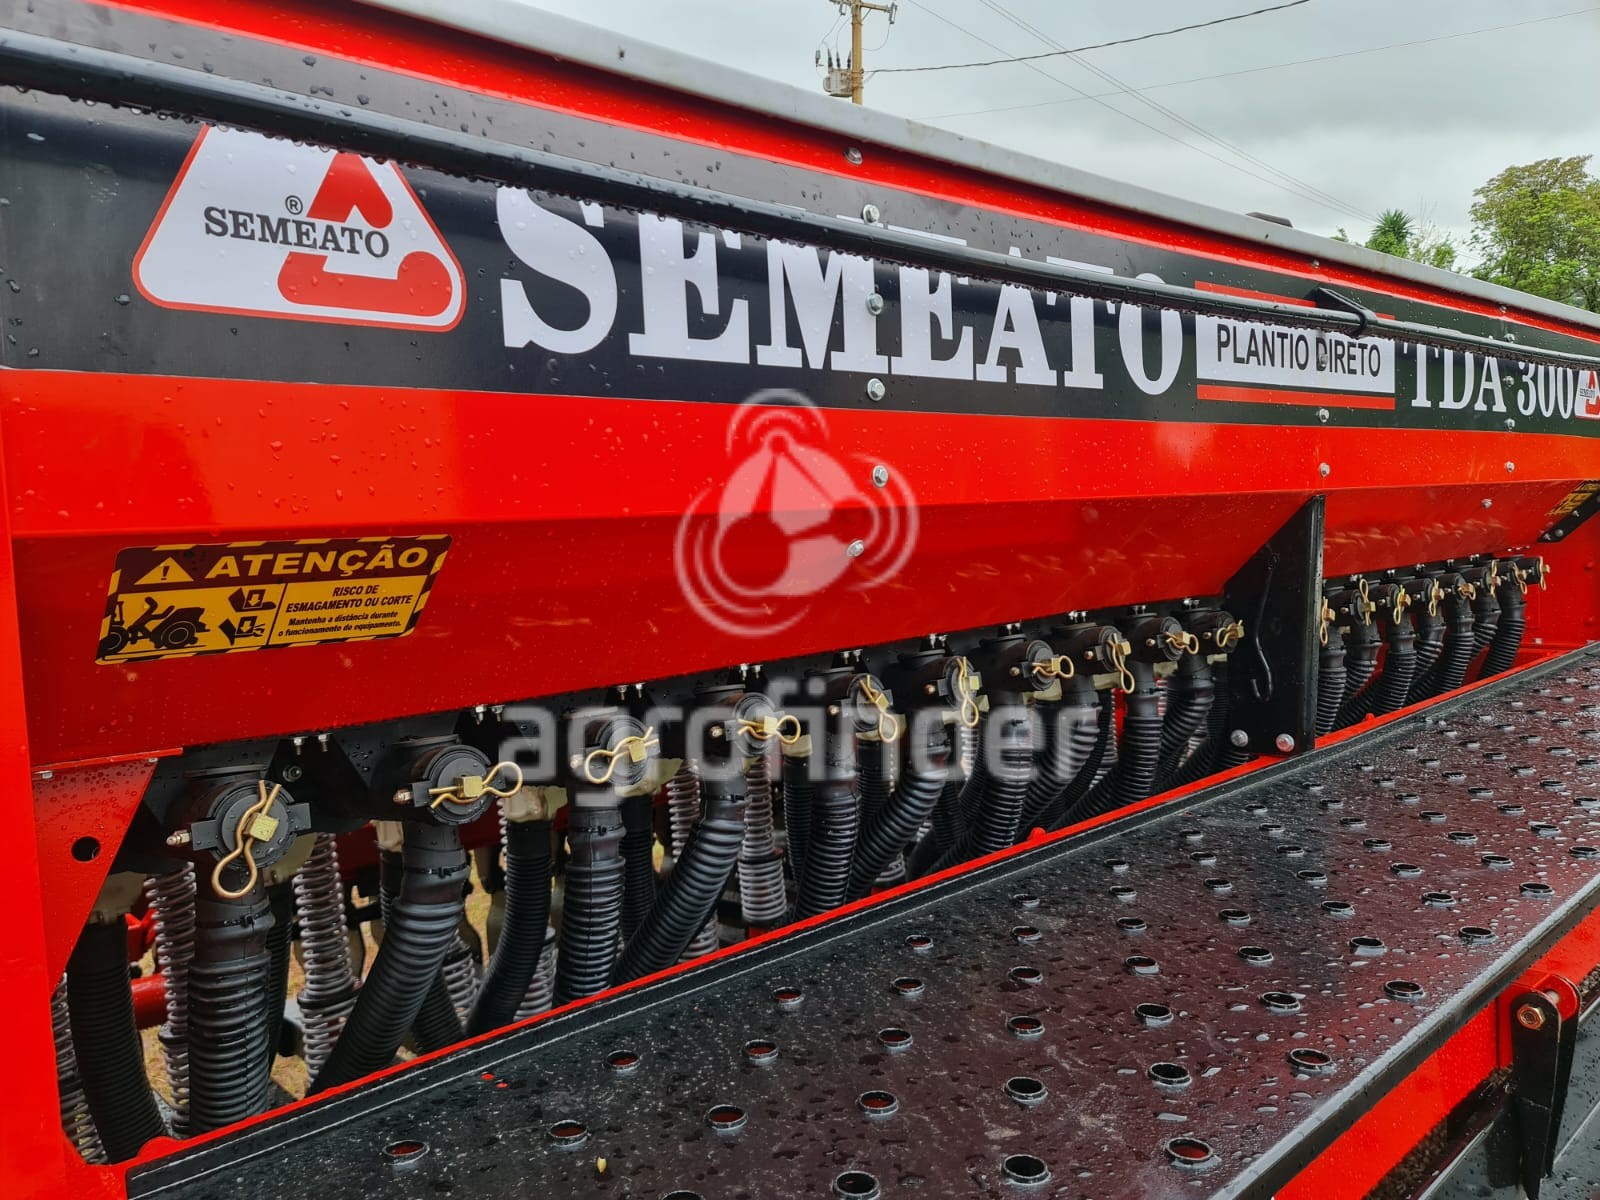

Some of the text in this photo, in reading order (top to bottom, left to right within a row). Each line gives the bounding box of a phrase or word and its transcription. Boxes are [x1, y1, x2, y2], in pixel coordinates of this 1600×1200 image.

[203, 206, 390, 259] SEMEATO
[496, 186, 1183, 395] SEMEATO
[1217, 323, 1381, 377] PLANTIO DIRETO
[1403, 342, 1574, 420] TDA 300
[204, 544, 428, 580] ATENÇÃO
[286, 594, 413, 613] ESMAGAMENTO OU CORTE
[332, 584, 380, 597] RISCO DE
[285, 624, 342, 637] funcionamento
[288, 615, 326, 626] Mantenha
[334, 612, 369, 624] distância
[370, 611, 399, 620] durante
